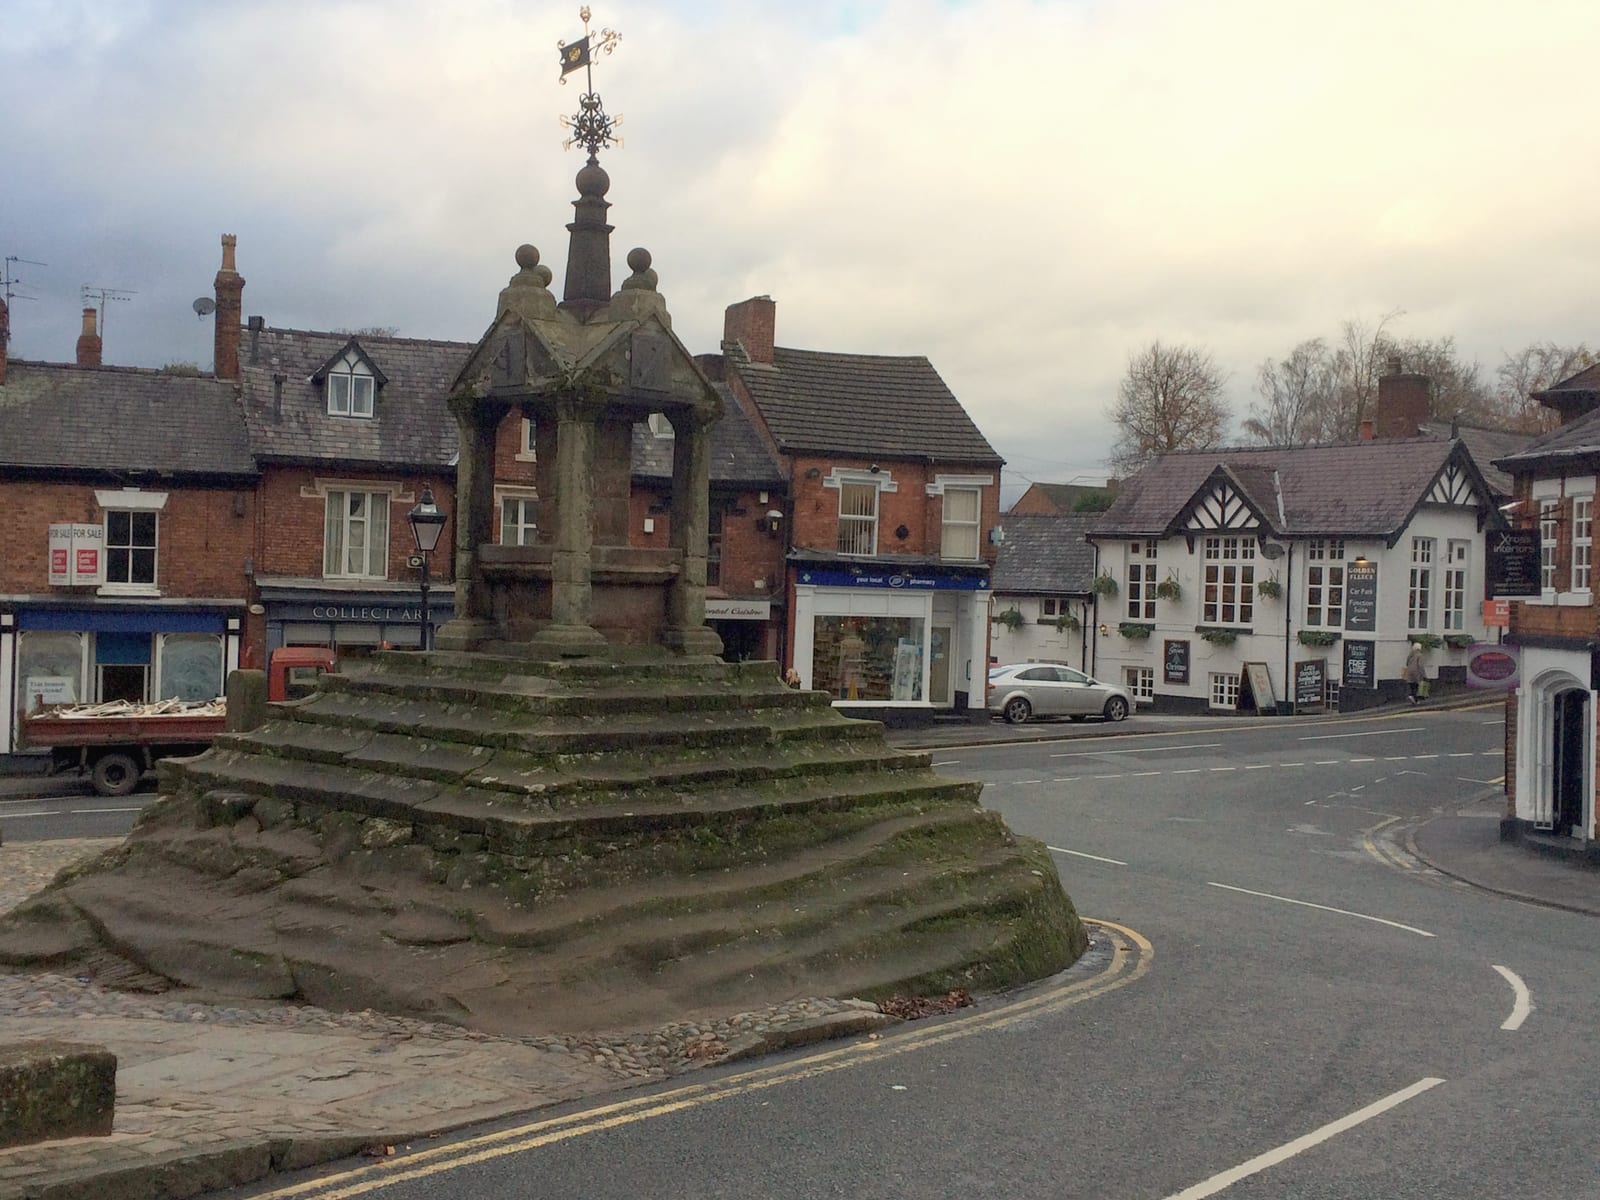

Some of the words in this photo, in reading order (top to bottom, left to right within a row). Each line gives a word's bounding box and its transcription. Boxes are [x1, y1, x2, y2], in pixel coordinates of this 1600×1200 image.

[73, 529, 86, 538] FOR
[87, 529, 102, 539] SALE
[312, 607, 393, 619] COLLECT
[401, 609, 433, 620] ART
